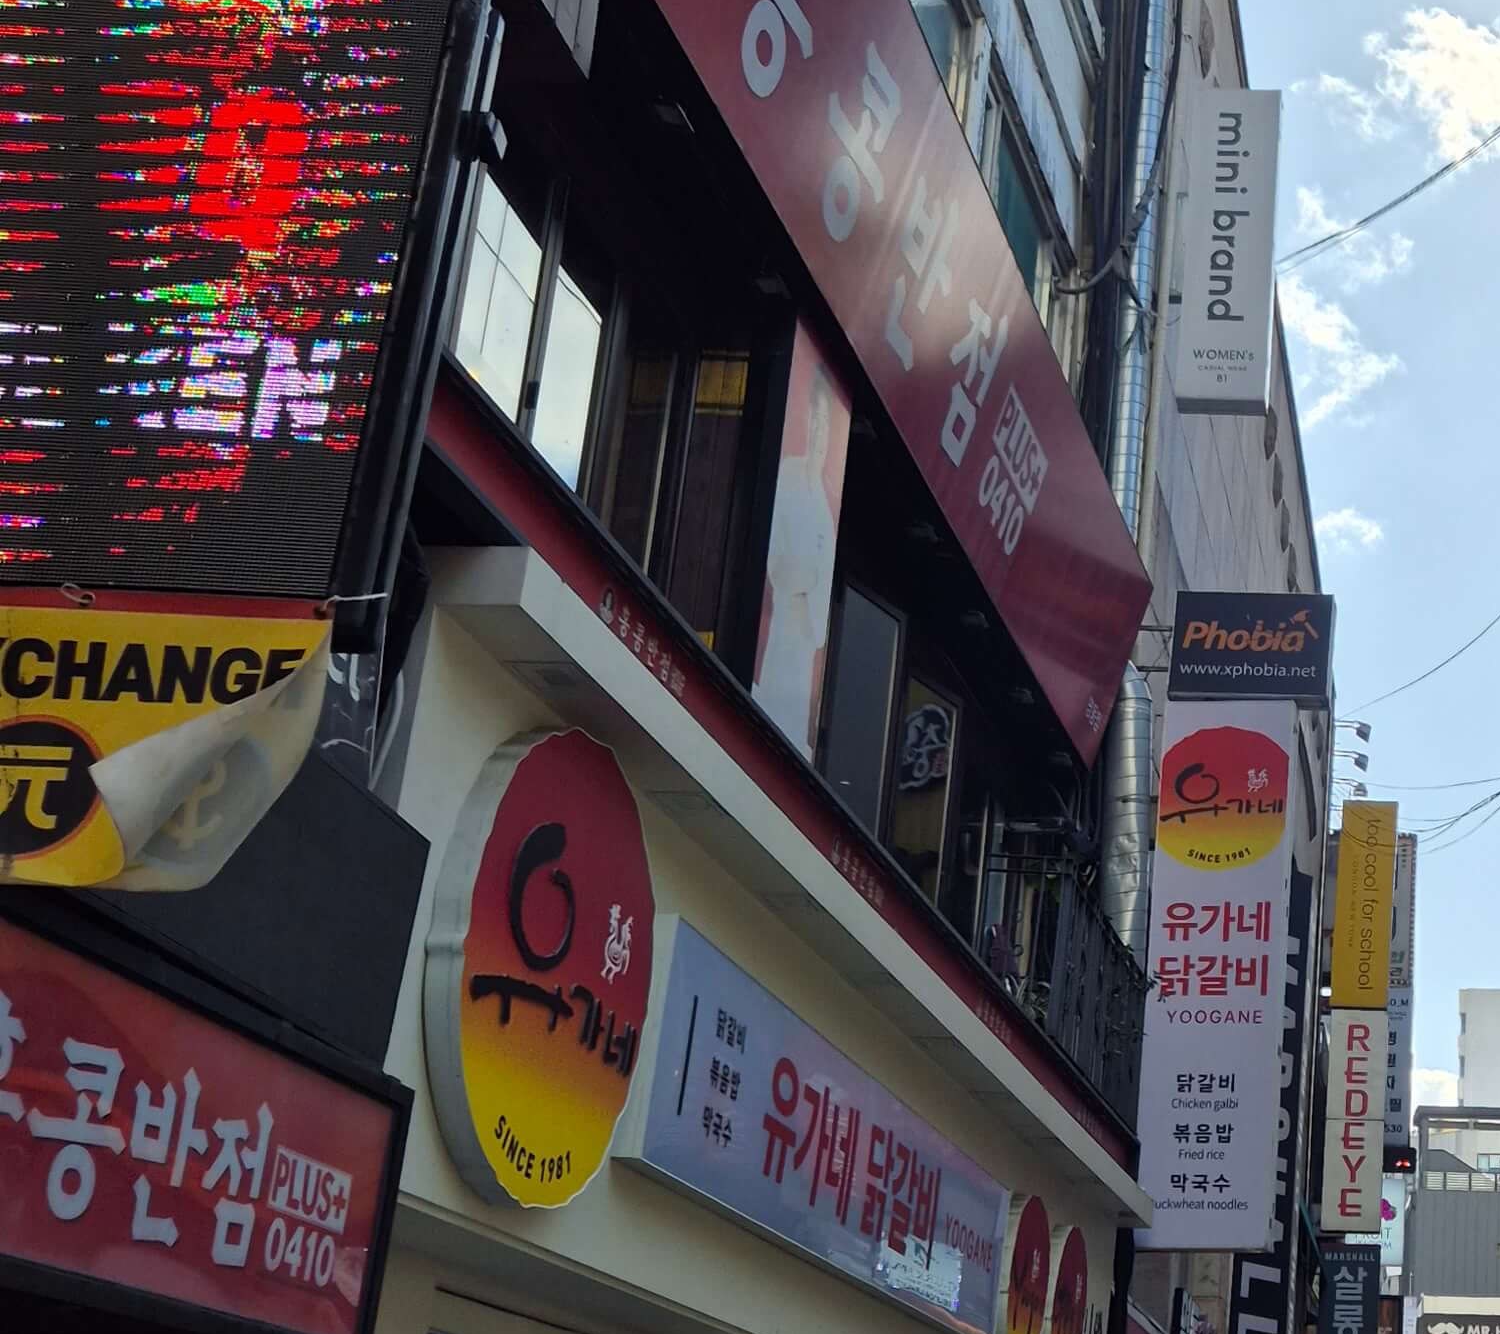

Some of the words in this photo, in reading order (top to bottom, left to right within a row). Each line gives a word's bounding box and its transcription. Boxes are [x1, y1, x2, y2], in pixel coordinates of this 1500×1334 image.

[1215, 112, 1250, 194] mini
[1207, 211, 1250, 322] brand
[979, 463, 1024, 556] 0410
[1182, 619, 1306, 652] Phobia
[1179, 662, 1317, 678] www.xphobia.net
[1366, 819, 1381, 847] too
[1187, 848, 1221, 864] SINCE
[1363, 852, 1379, 892] cool
[1162, 901, 1272, 943] 유가네
[1361, 898, 1379, 923] for
[1158, 954, 1269, 997] 닭갈비
[1357, 928, 1377, 991] school
[1166, 1009, 1263, 1025] YOOGANE
[1176, 1072, 1236, 1094] 닭갈비
[1171, 1098, 1212, 1110] Chicken
[1213, 1098, 1239, 1112] galbi
[1338, 1024, 1372, 1218] REDEYE
[0, 990, 274, 1269] 콩반점
[1172, 1123, 1235, 1144] 볶음밥
[493, 1114, 535, 1180] SINCE
[538, 1150, 573, 1184] 1981
[762, 1056, 861, 1226] 유가네
[859, 1123, 942, 1271] 닭갈비
[1178, 1148, 1205, 1160] Fried
[1206, 1149, 1225, 1160] rice
[1170, 1173, 1232, 1194] 막국수
[1152, 1198, 1206, 1210] uckwheat
[1207, 1198, 1249, 1210] noodles
[264, 1221, 336, 1287] 0410
